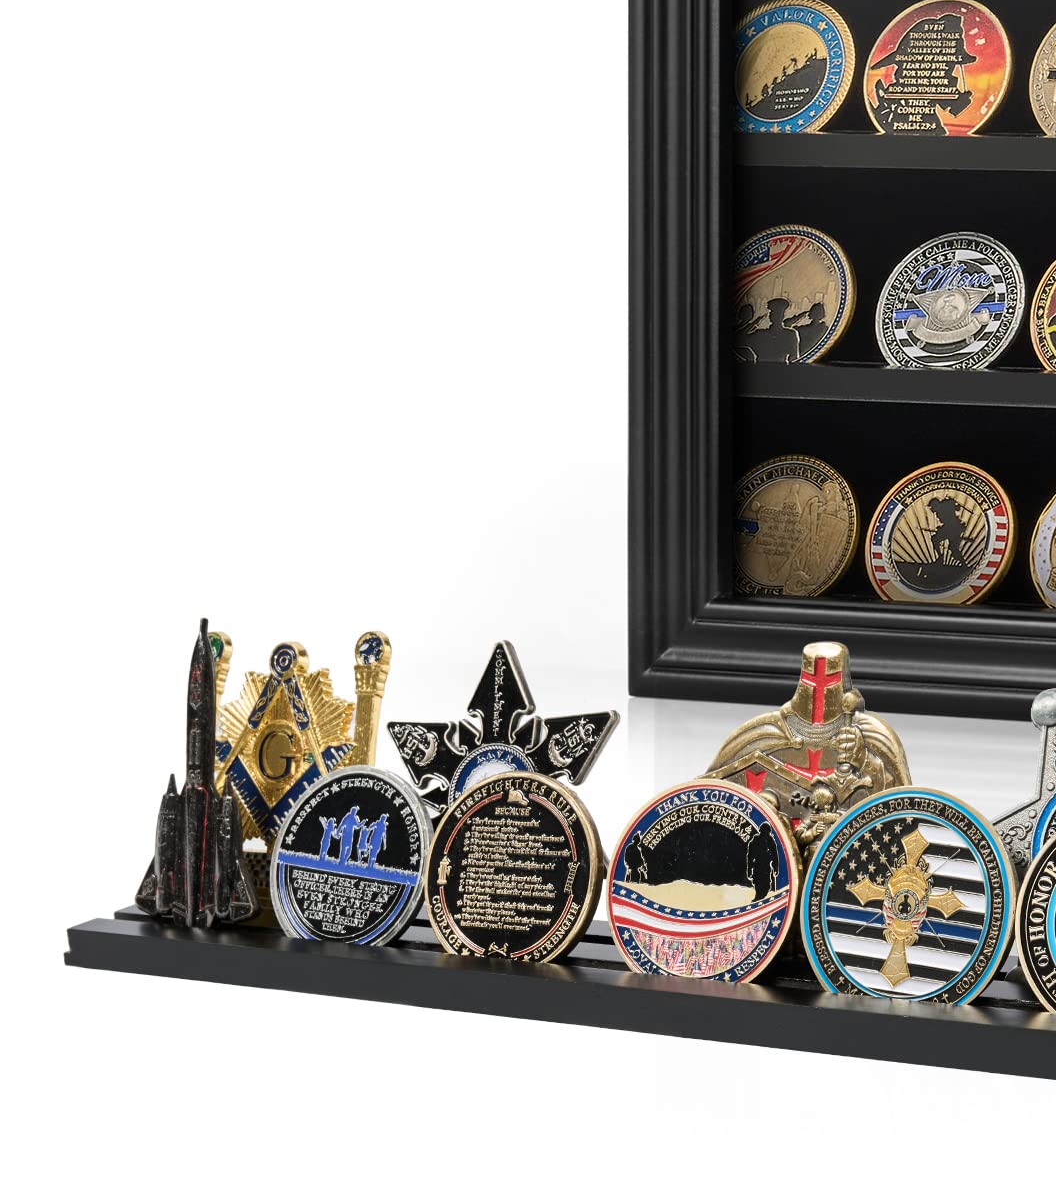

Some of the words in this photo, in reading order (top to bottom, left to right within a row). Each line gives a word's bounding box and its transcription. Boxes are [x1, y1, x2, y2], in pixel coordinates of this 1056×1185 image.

[818, 31, 843, 109] SACRIFICE
[883, 287, 897, 316] SOME
[896, 255, 924, 288] PEOPLE
[926, 242, 950, 257] CALL
[953, 240, 968, 249] ME
[970, 241, 977, 249] A
[977, 243, 1006, 267] POLICE
[1002, 265, 1017, 308] OFFICER
[916, 264, 991, 291] Mom
[737, 472, 770, 503] SAINT
[772, 465, 826, 486] MICHAEL
[259, 731, 296, 780] G
[455, 779, 546, 818] FIREFIGHTERS
[549, 789, 578, 824] RULE
[495, 807, 531, 815] BECAUSE
[656, 790, 699, 816] THANK
[702, 789, 730, 804] YOU
[730, 797, 754, 816] FOR
[889, 799, 910, 813] FOR
[914, 798, 944, 814] THEY
[945, 805, 969, 829] WILL
[400, 808, 420, 854] HONOR
[642, 811, 678, 846] SERVING
[679, 805, 700, 815] OUR
[701, 805, 746, 827] COUNTRY
[649, 815, 692, 850] PROTECTING
[693, 814, 712, 823] OUR
[711, 814, 750, 843] FREEDOMS
[968, 827, 982, 842] BE
[292, 869, 327, 883] BEHIND
[814, 868, 827, 897] THE
[978, 842, 1000, 887] CALLED
[431, 895, 461, 951] COURAGE
[532, 902, 581, 960] STRENGTH
[984, 888, 1004, 957] CHILDREN
[734, 930, 776, 977] RESPECT
[812, 924, 836, 974] BLESSED
[975, 956, 987, 974] OF
[1033, 946, 1050, 967] OF
[956, 973, 976, 995] GOD
